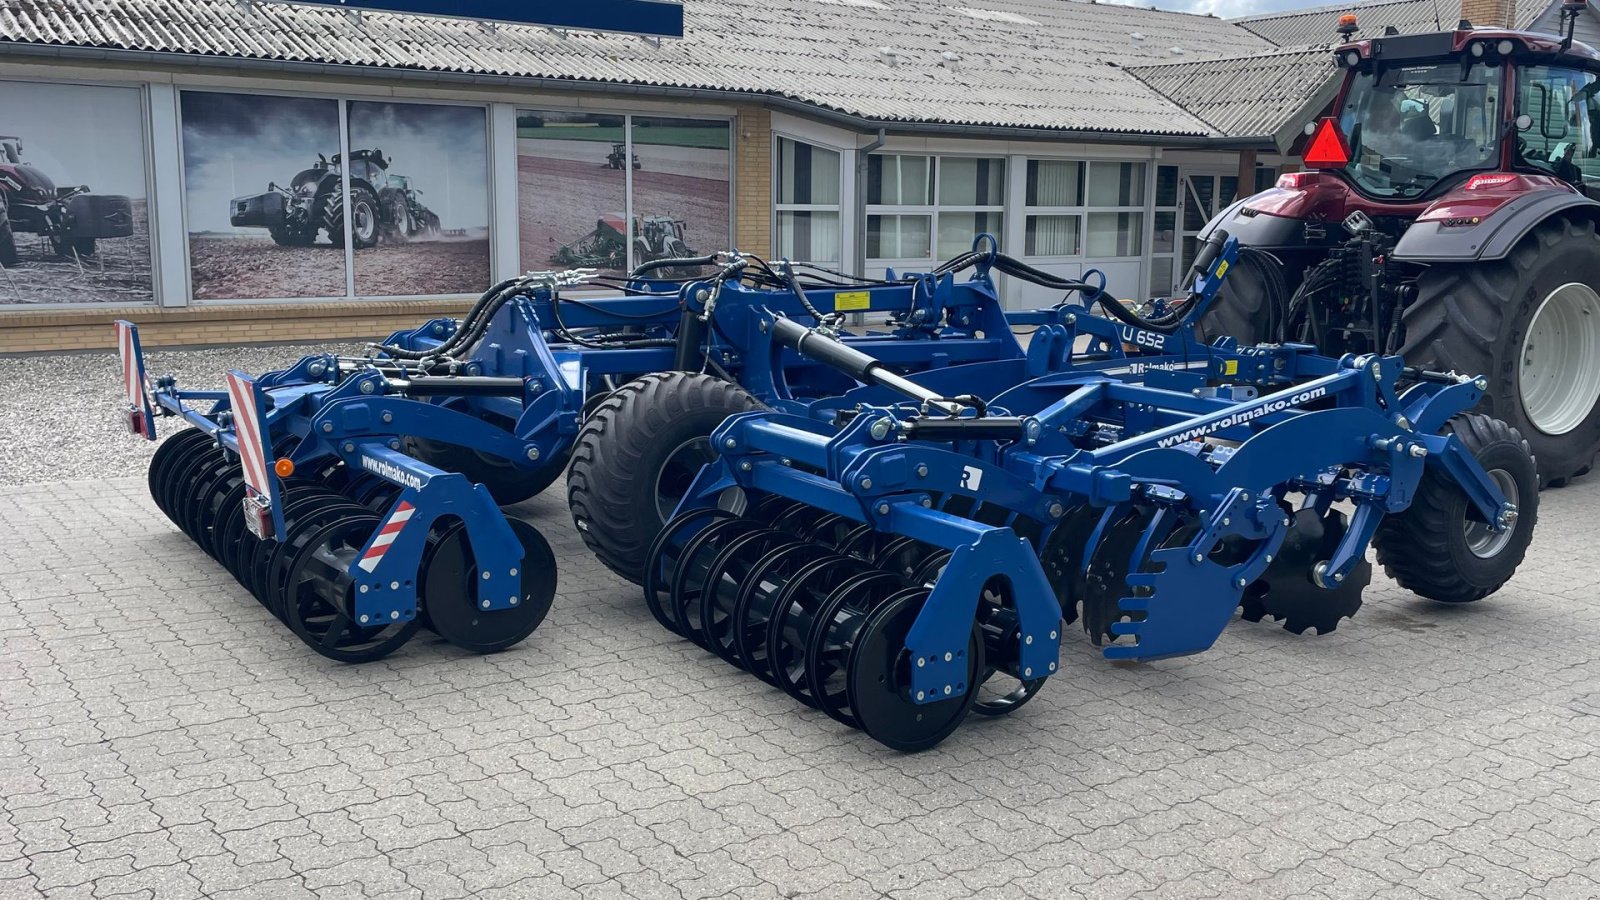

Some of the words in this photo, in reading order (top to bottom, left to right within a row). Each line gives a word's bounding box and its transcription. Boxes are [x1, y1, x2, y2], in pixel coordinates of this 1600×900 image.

[1122, 325, 1134, 342] U
[1136, 330, 1165, 349] 652
[1157, 386, 1326, 449] www.rolmako.com
[361, 454, 421, 493] www.rolmako.com
